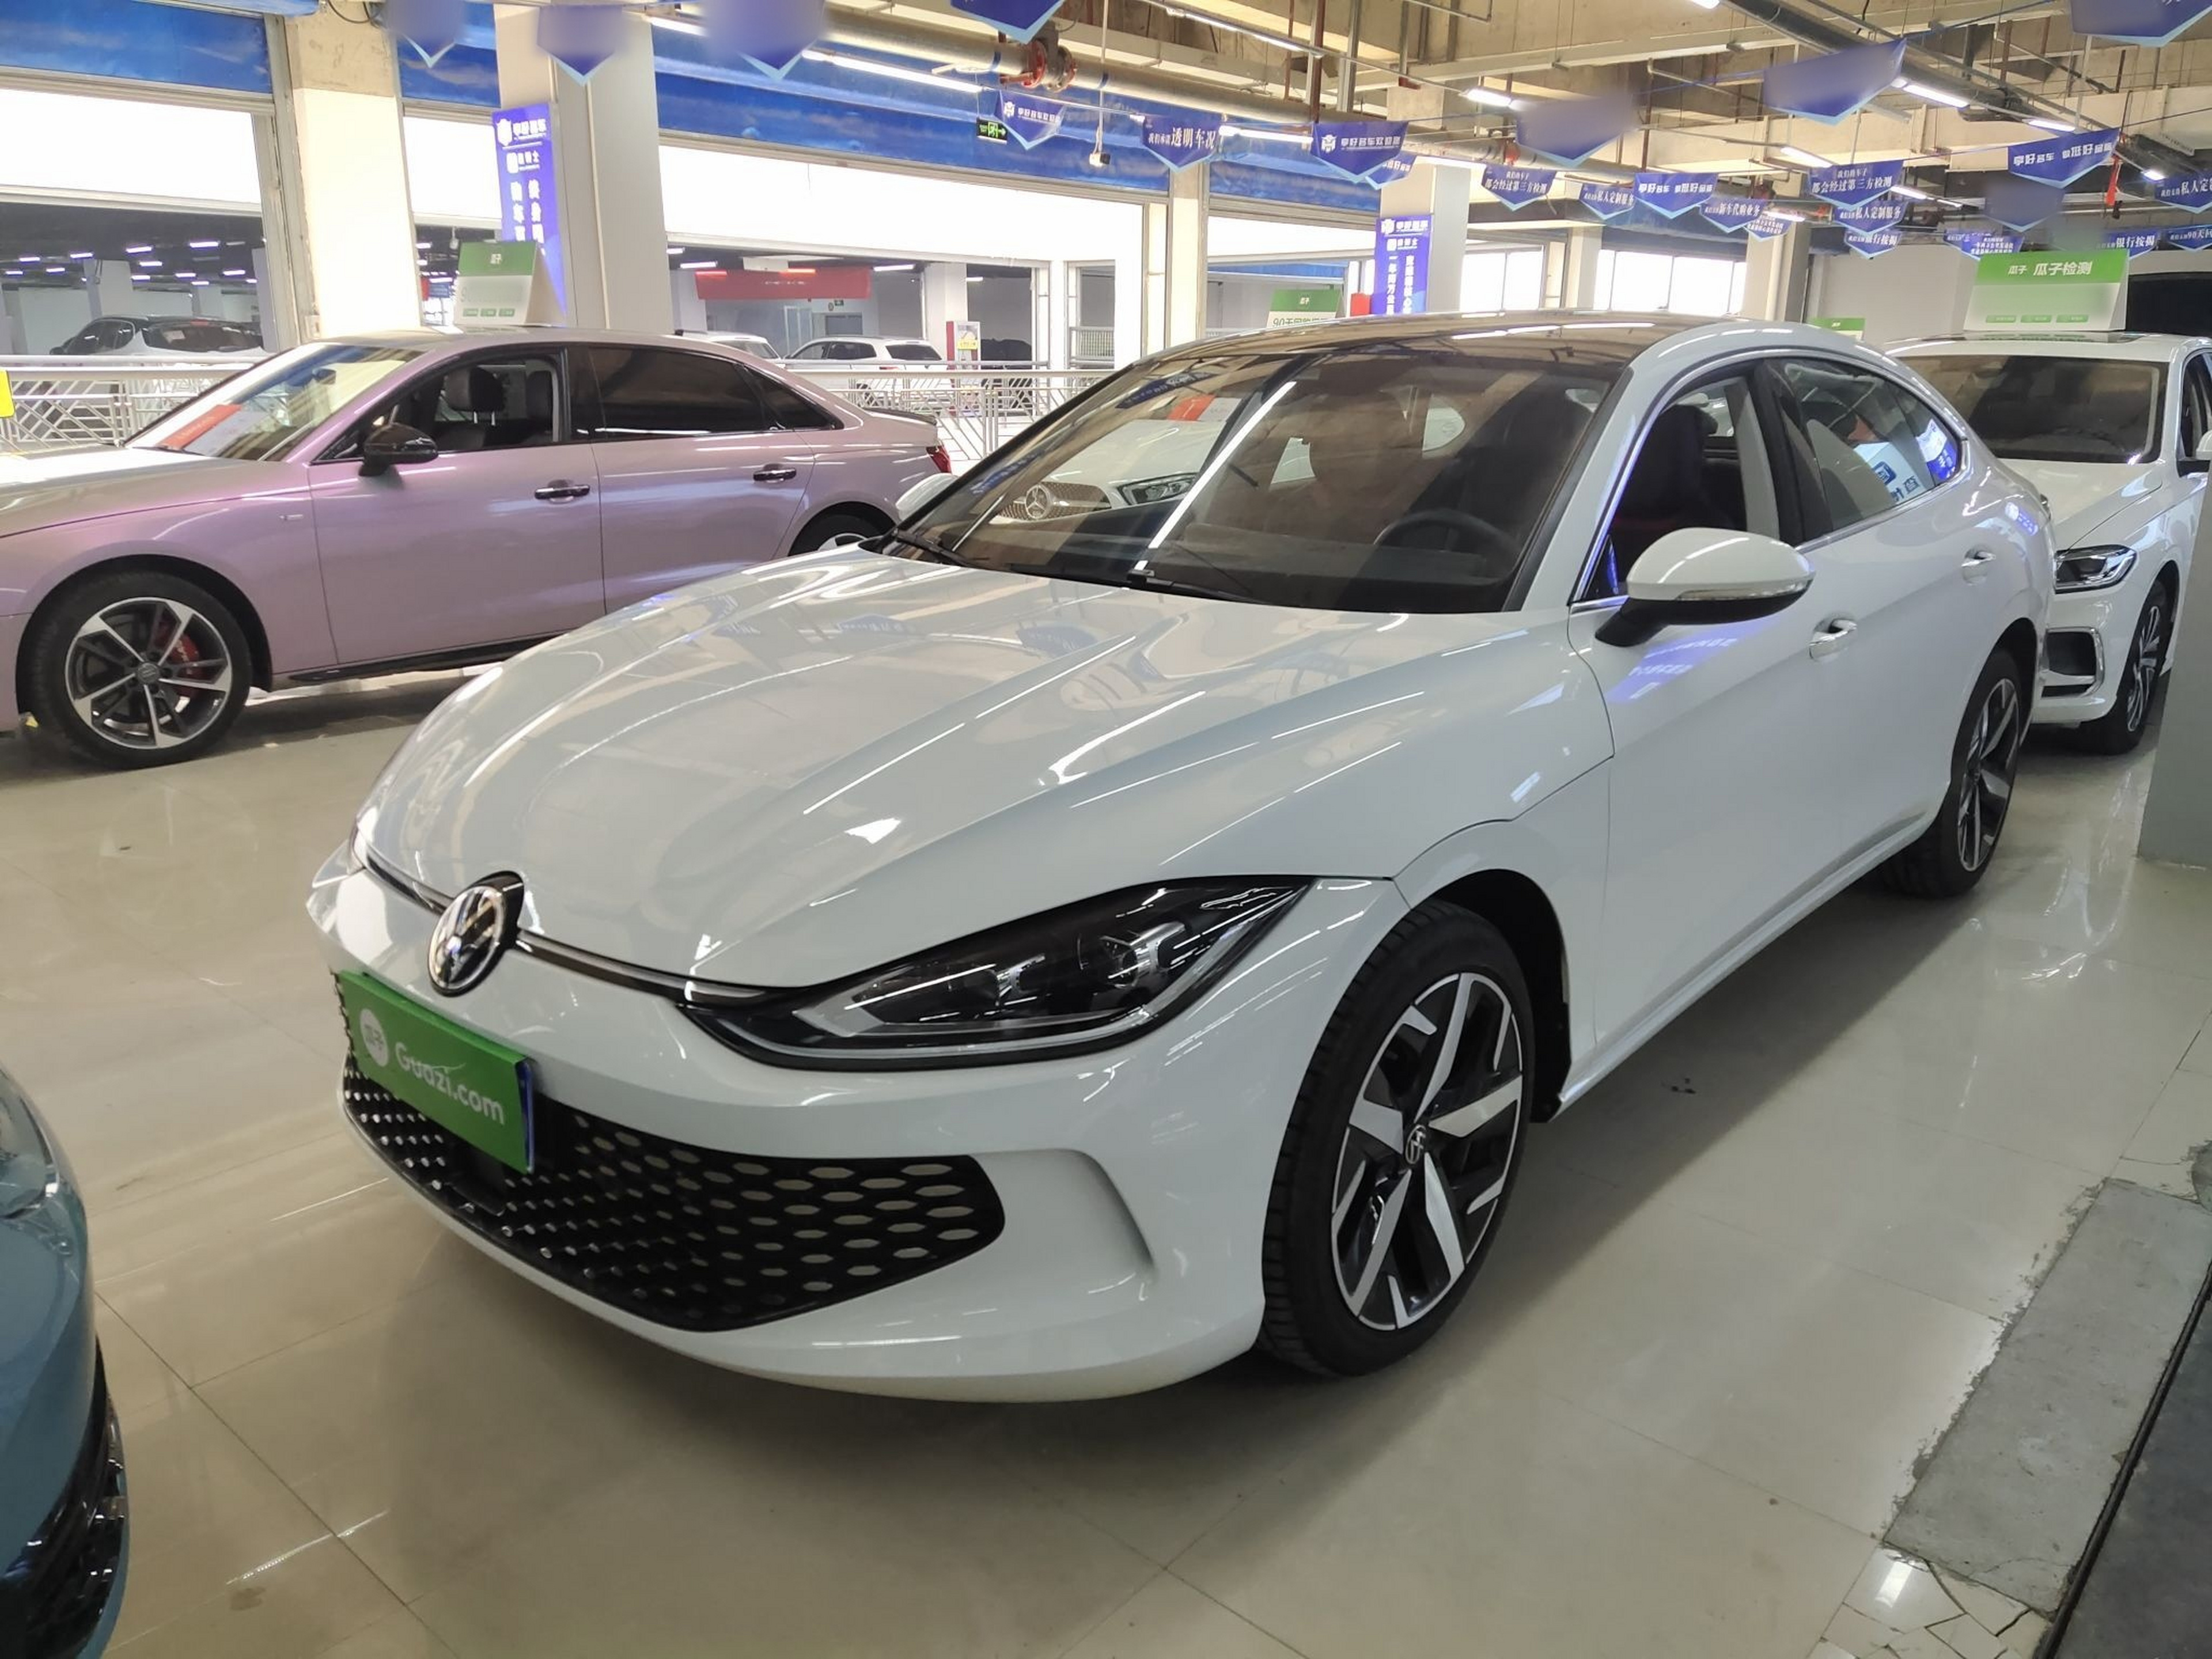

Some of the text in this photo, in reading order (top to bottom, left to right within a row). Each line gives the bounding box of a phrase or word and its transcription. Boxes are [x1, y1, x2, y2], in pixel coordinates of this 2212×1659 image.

[1812, 175, 1893, 193] 都会经过第三方检测
[2161, 177, 2212, 197] 我们支持私人定
[2033, 261, 2093, 276] 瓜子检测
[395, 1040, 505, 1126] Guazi.com
